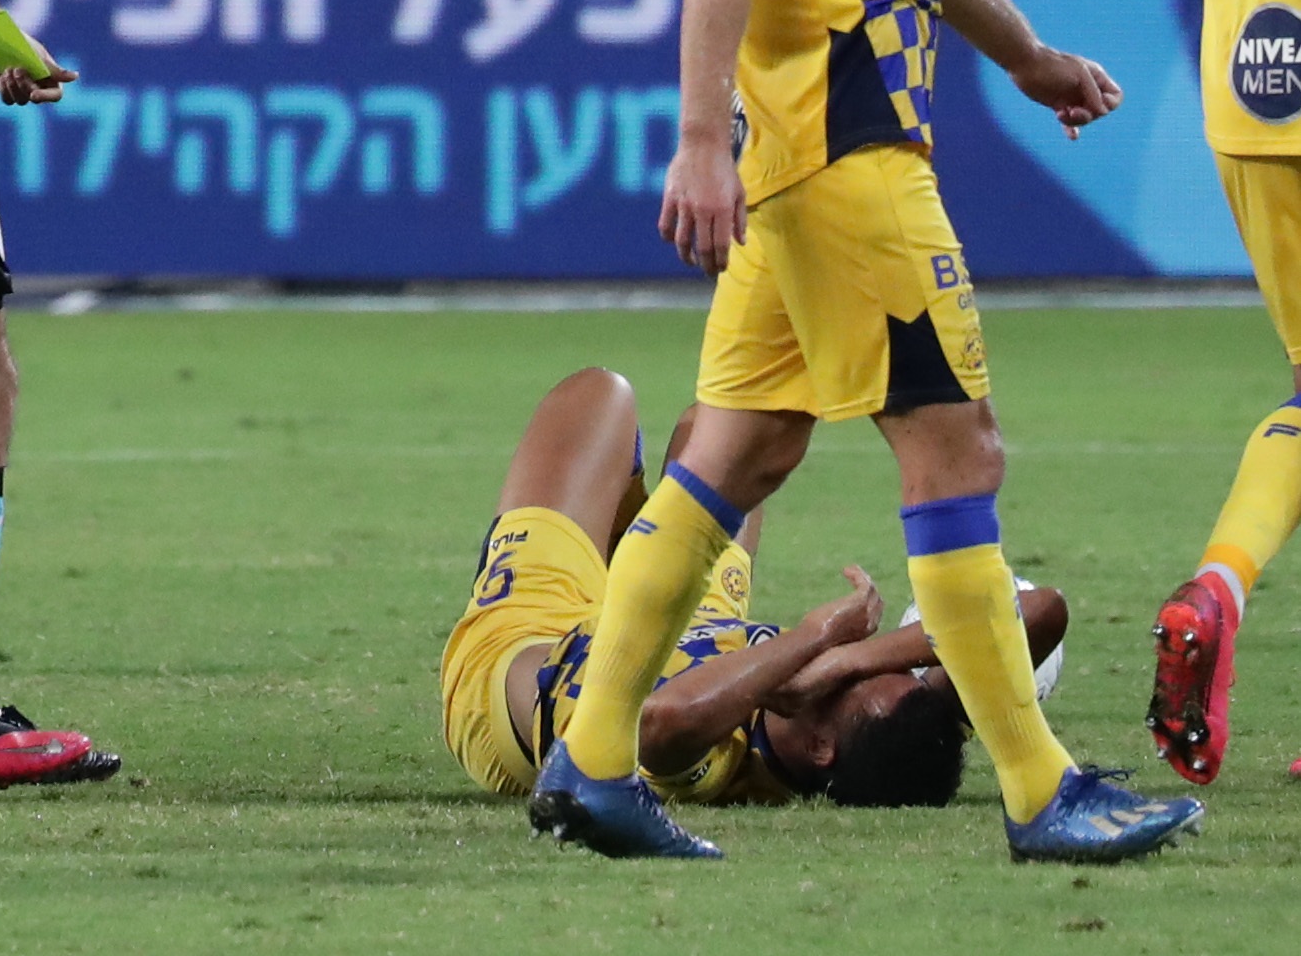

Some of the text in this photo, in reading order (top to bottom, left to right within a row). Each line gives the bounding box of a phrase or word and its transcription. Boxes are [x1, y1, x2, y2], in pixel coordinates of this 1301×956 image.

[1238, 37, 1301, 65] NIVE
[1242, 69, 1301, 94] MEN
[484, 84, 683, 235] מען
